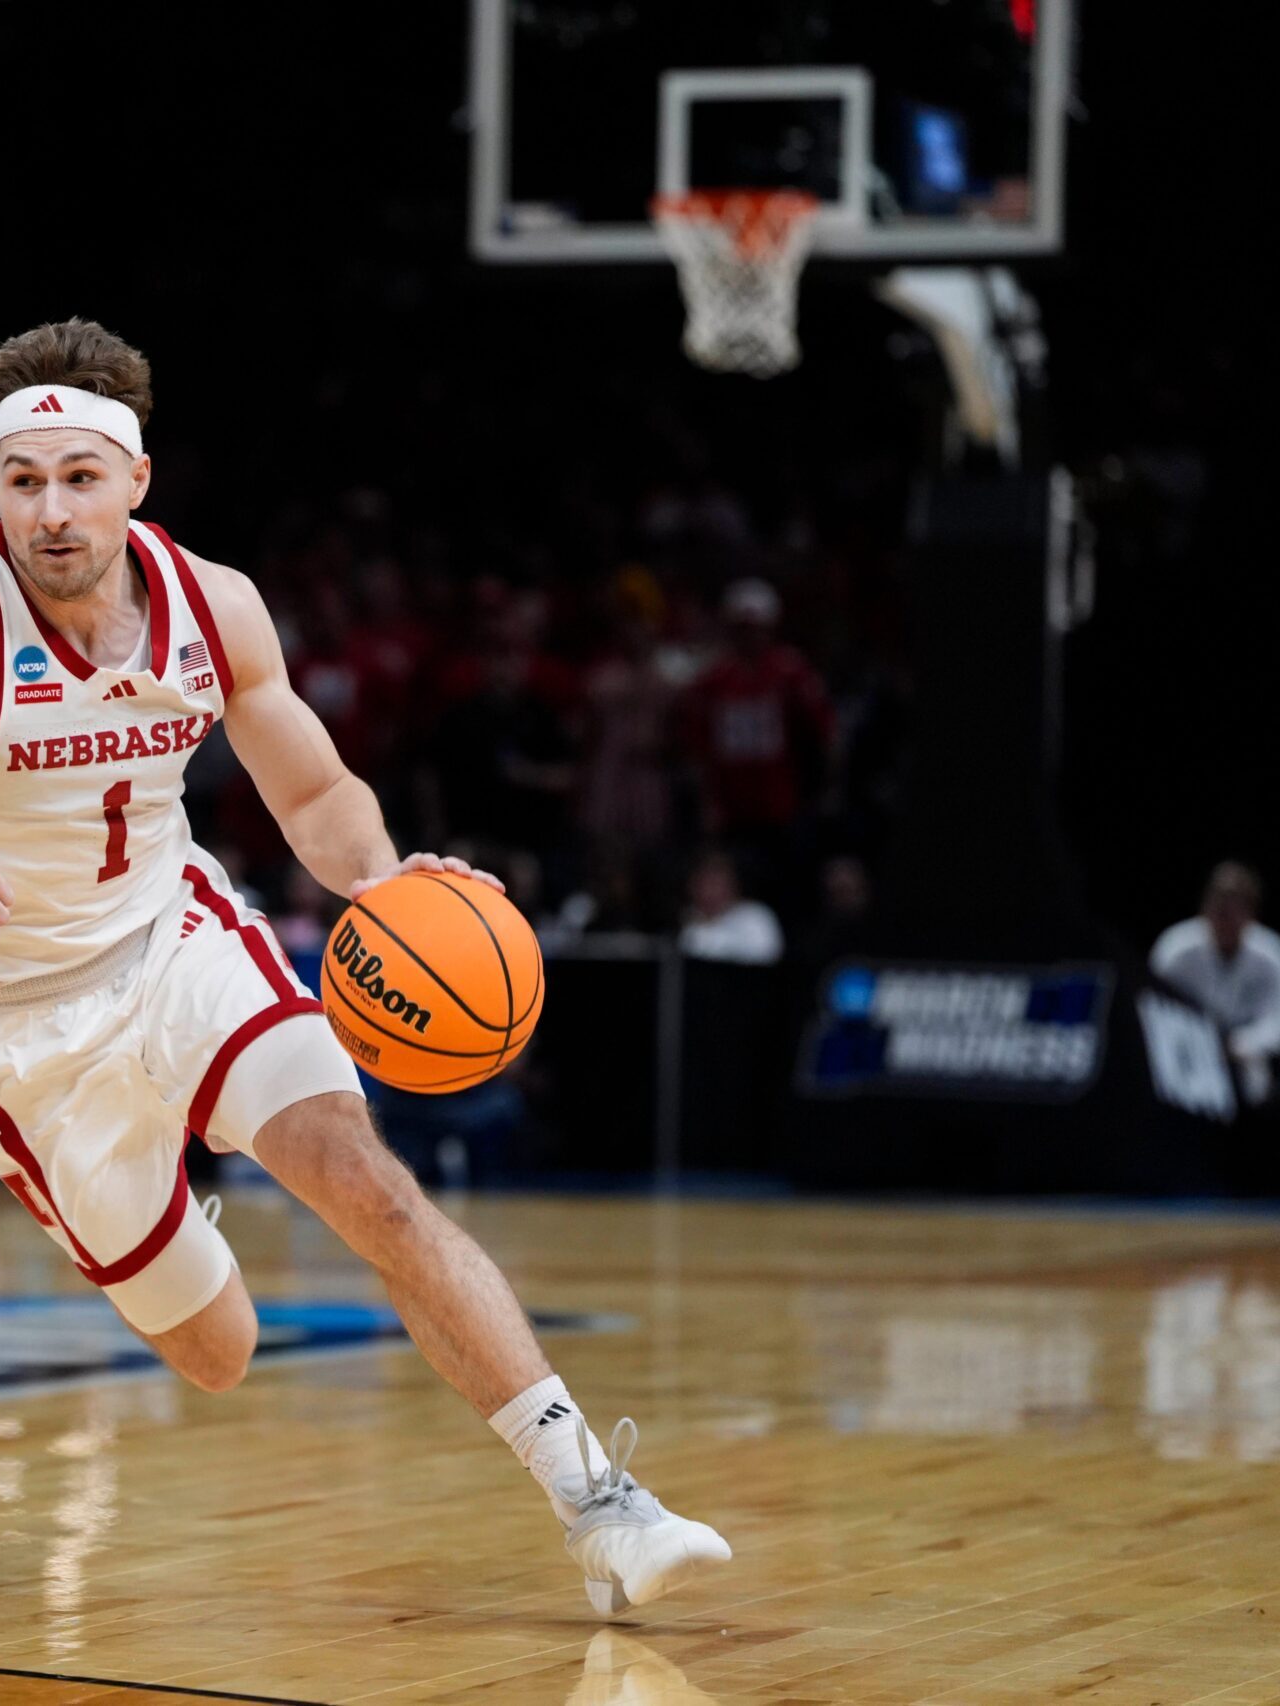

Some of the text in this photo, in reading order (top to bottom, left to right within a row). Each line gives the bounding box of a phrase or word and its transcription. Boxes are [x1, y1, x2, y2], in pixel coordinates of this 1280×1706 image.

[17, 688, 62, 700] GRADUATE
[18, 662, 46, 673] NCAA
[97, 780, 132, 884] 1
[332, 917, 432, 1034] Wilson
